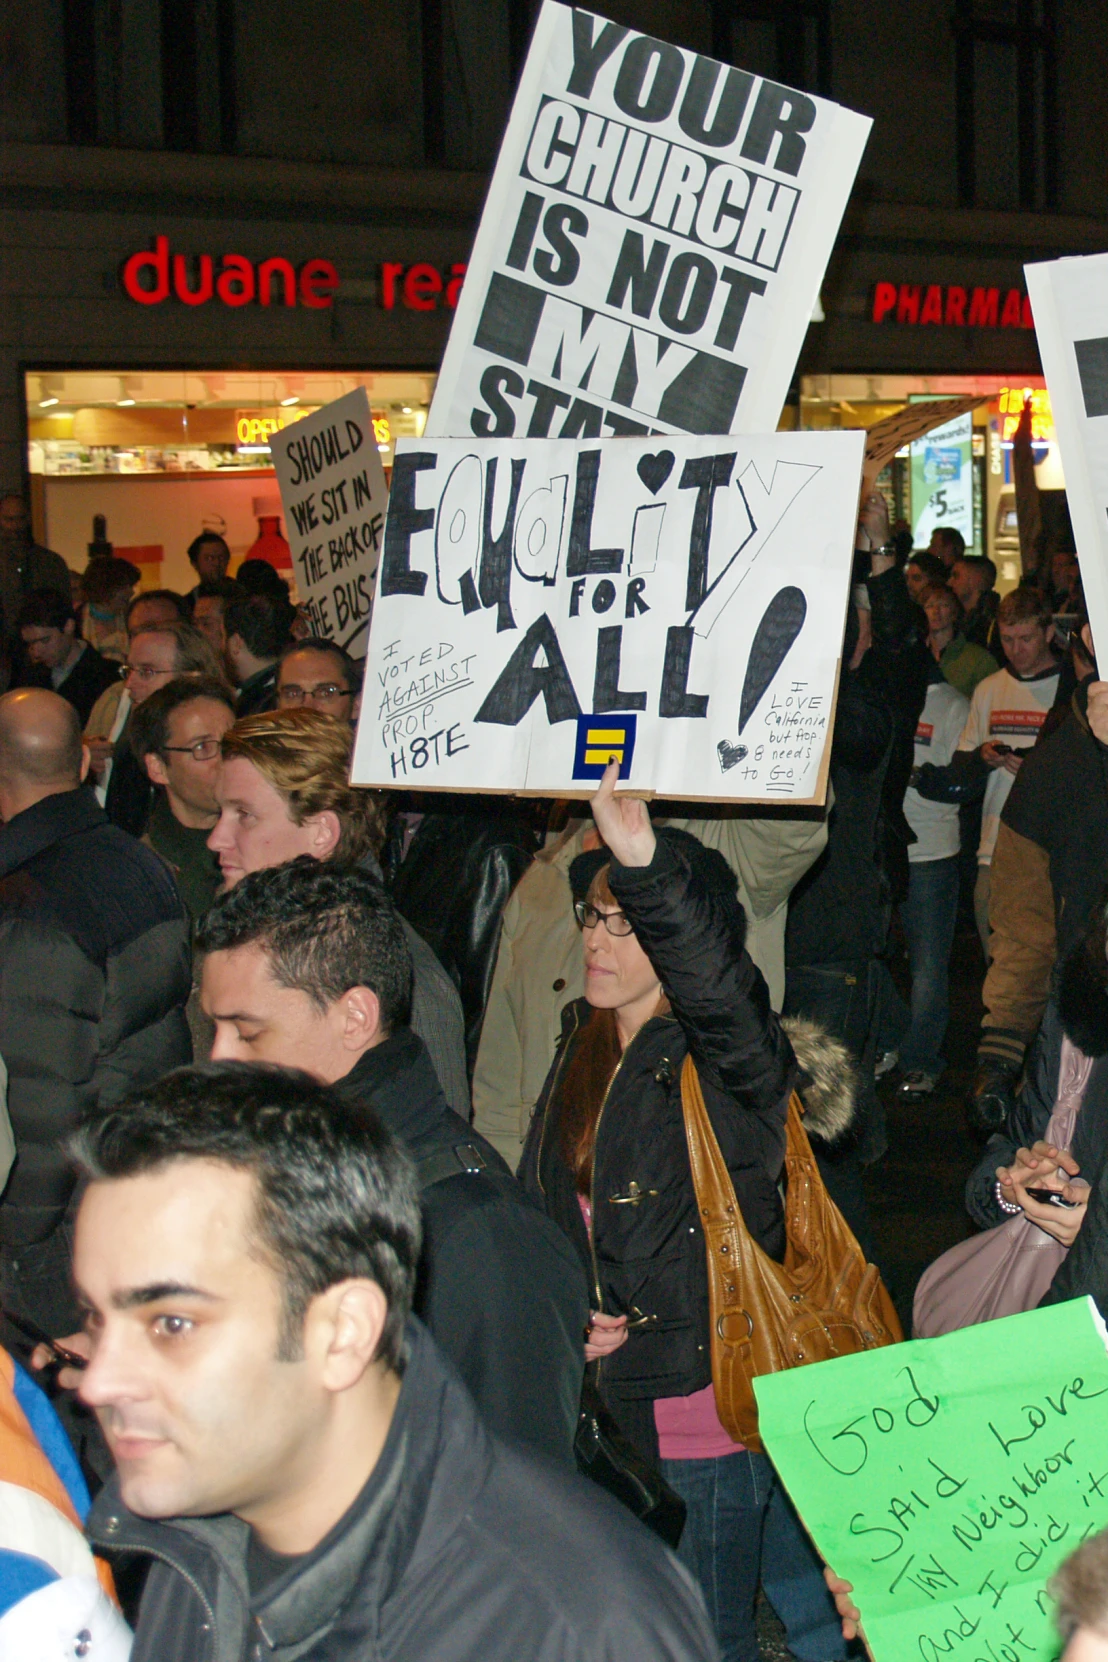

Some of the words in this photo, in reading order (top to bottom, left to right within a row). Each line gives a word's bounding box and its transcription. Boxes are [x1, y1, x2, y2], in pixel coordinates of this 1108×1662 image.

[566, 8, 817, 177] YOUR
[525, 98, 800, 270] CHURCH
[122, 236, 340, 308] duane
[505, 190, 590, 287] IS
[605, 228, 768, 353] NOT
[528, 294, 699, 418] MY
[286, 419, 364, 486] SHOULD
[289, 492, 320, 537] WE
[320, 479, 349, 526] SIT
[351, 469, 372, 511] IN
[298, 543, 329, 588] THE
[327, 525, 365, 574] BACK
[361, 512, 385, 553] OF
[568, 577, 651, 618] FOR
[378, 642, 455, 688] VOTED
[382, 639, 402, 661] I
[378, 654, 478, 721] AGAINST
[764, 711, 826, 728] California
[770, 694, 824, 709] LOVE
[790, 681, 809, 693] I
[382, 704, 438, 748] PROP.
[390, 722, 471, 779] H8TE
[754, 744, 765, 761] 8
[772, 746, 812, 760] needs
[769, 729, 792, 744] but
[741, 766, 759, 780] to
[804, 1366, 940, 1476] God
[952, 1437, 1076, 1552] Neighbor
[918, 1604, 982, 1662] and
[978, 1569, 1009, 1610] I
[1014, 1513, 1070, 1573] did
